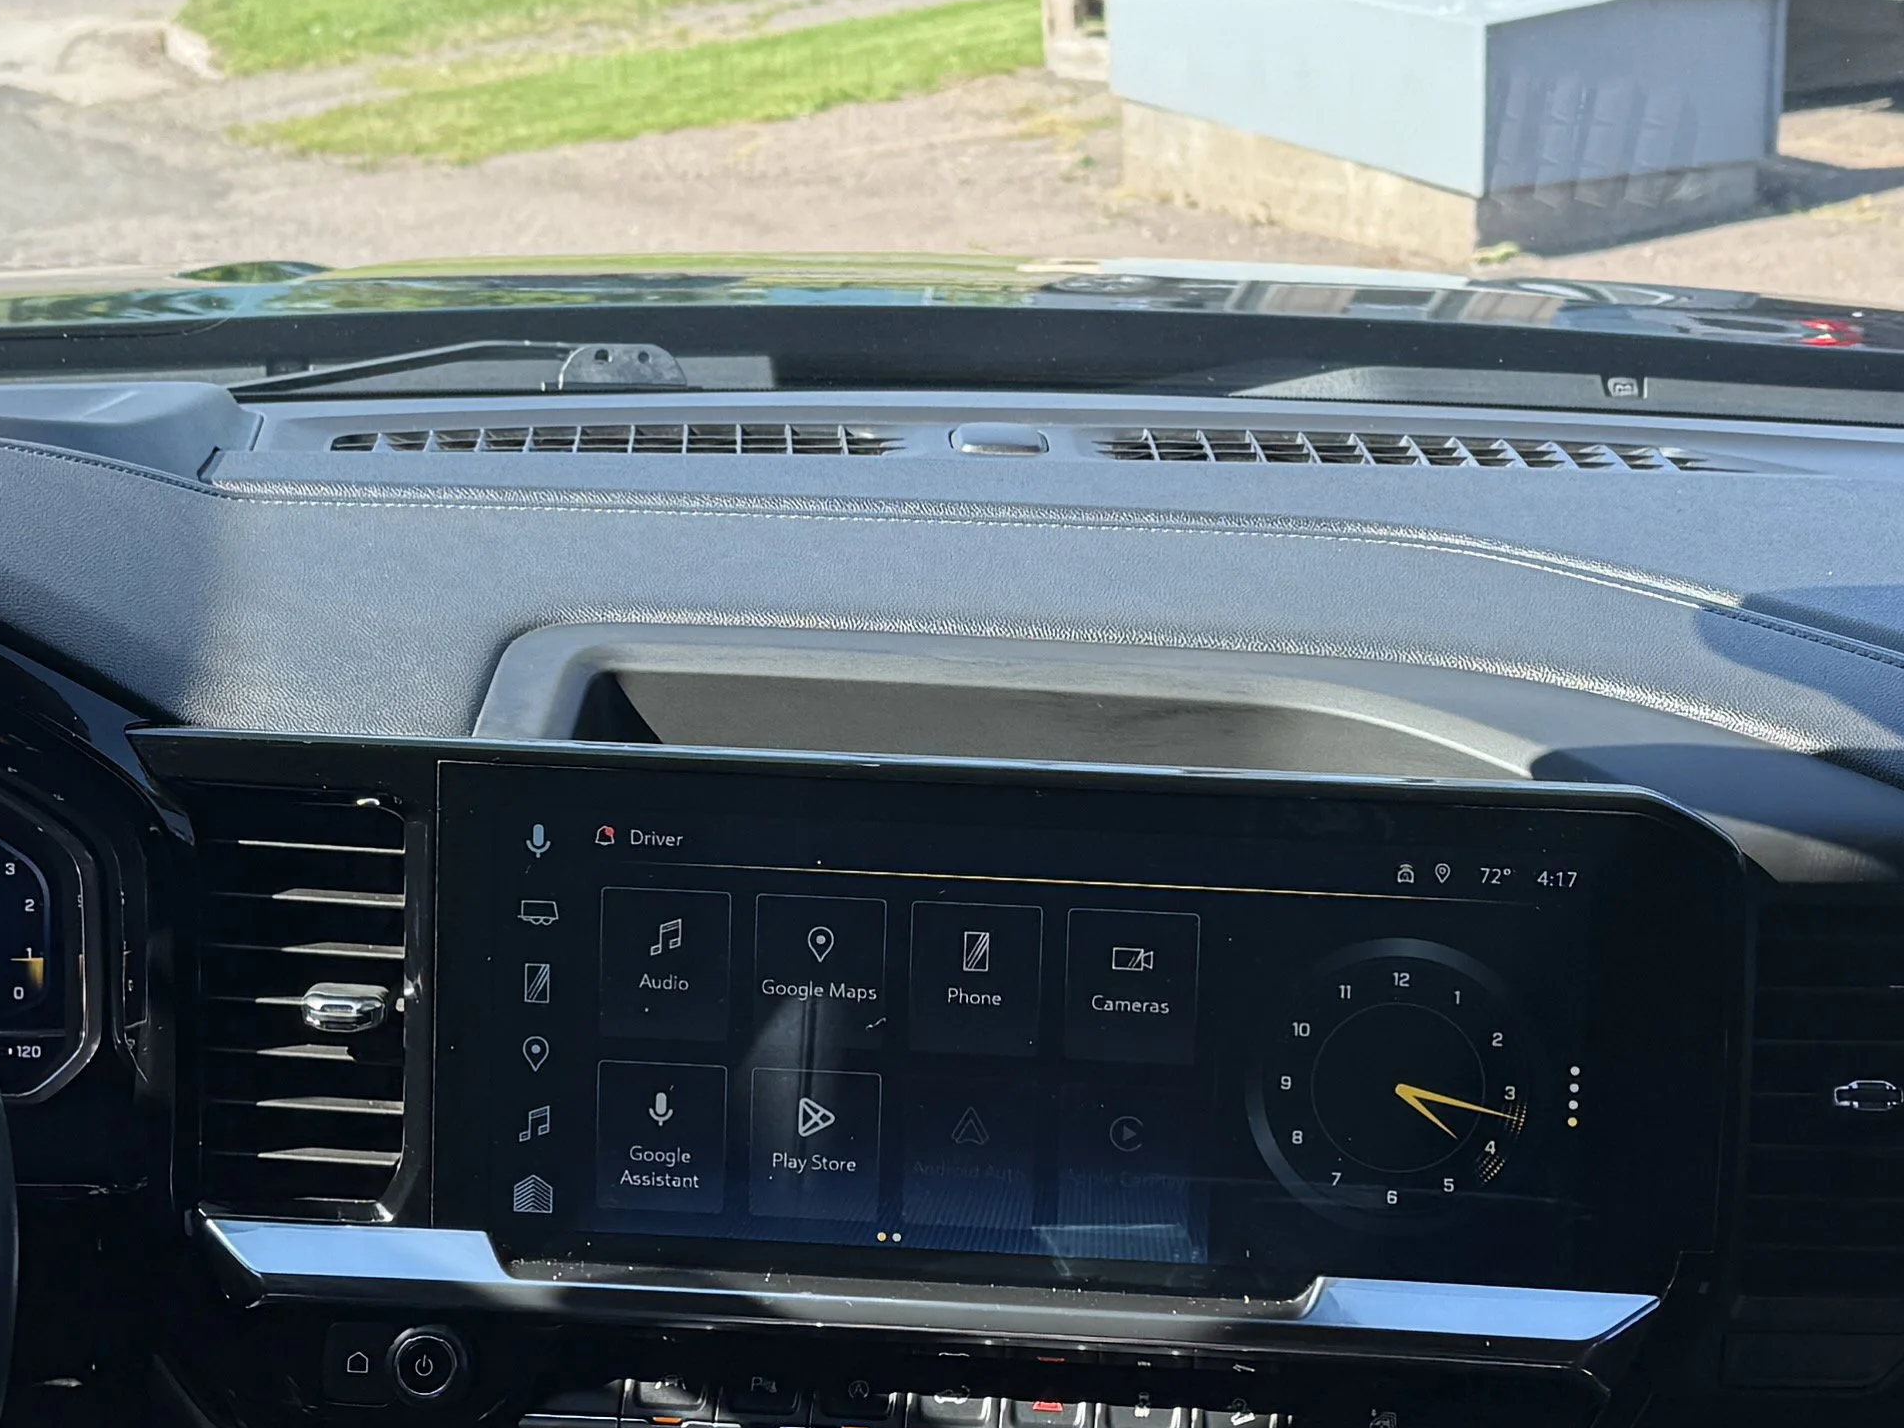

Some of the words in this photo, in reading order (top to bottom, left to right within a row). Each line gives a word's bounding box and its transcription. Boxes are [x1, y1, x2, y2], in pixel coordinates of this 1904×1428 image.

[629, 828, 684, 847] Driver
[4, 861, 17, 877] 3
[1536, 870, 1579, 888] 4:17
[23, 898, 36, 913] 2
[638, 973, 690, 992] Audio
[1393, 971, 1411, 987] 12
[12, 986, 26, 1001] 0
[760, 978, 824, 1000] Google
[829, 982, 878, 1003] Maps
[947, 987, 1003, 1007] Phone
[1338, 984, 1352, 1000] 11
[1454, 989, 1462, 1004] 1
[1090, 994, 1170, 1015] Cameras
[1292, 1022, 1311, 1038] 10
[1491, 1032, 1504, 1047] 2
[16, 1044, 43, 1059] 120
[1279, 1075, 1293, 1090] 9
[1503, 1085, 1517, 1101] 3
[1290, 1129, 1304, 1145] 8
[1484, 1139, 1498, 1155] 4
[629, 1144, 692, 1167] Google
[771, 1151, 807, 1174] Play
[811, 1154, 857, 1172] Store
[619, 1169, 700, 1189] Assistant
[1330, 1171, 1343, 1187] 7
[1442, 1177, 1455, 1193] 5
[1385, 1189, 1399, 1205] 6
